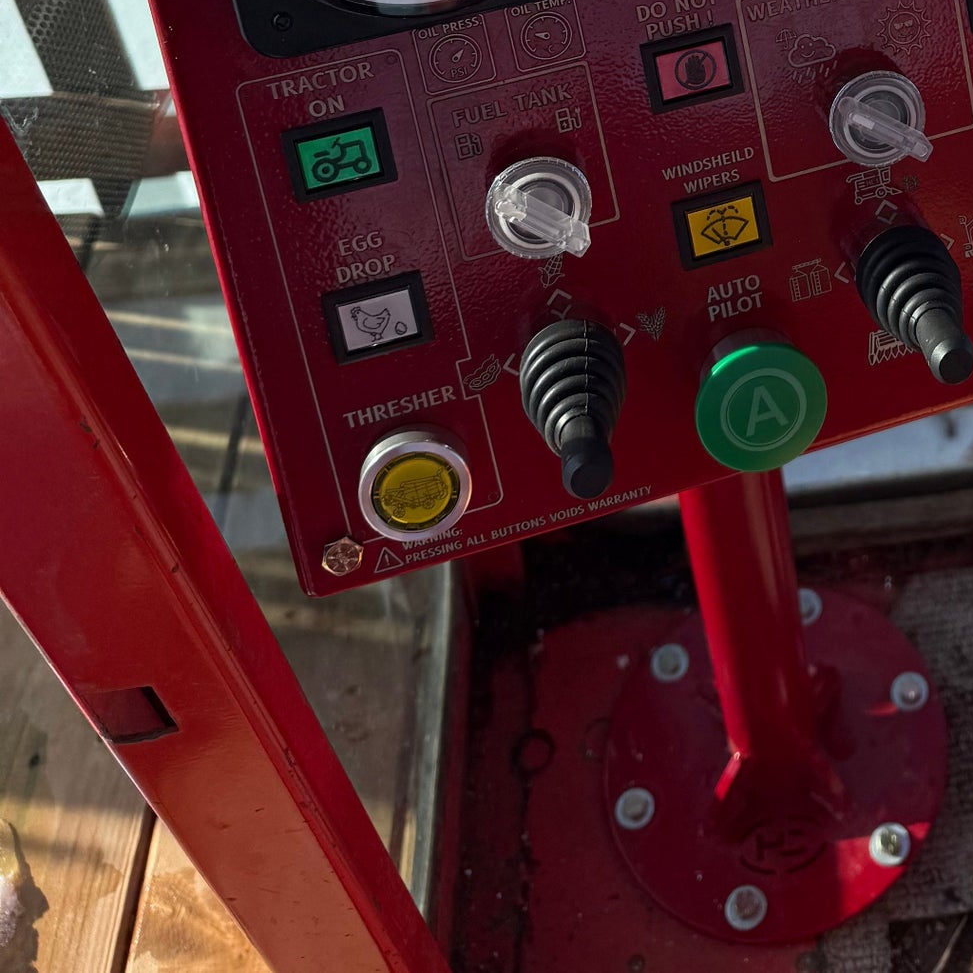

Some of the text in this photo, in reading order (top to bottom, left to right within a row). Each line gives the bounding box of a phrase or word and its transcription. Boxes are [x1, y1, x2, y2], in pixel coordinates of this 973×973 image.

[511, 5, 531, 17] OIL
[635, 2, 667, 24] DO
[418, 16, 483, 40] OIL PRESS.
[266, 61, 374, 100] TRACTOR
[451, 67, 468, 78] PSI
[309, 95, 345, 118] ON
[451, 82, 574, 128] FUEL TANK
[662, 147, 755, 180] WINDSHEILD
[684, 168, 740, 194] WIPERS
[338, 231, 383, 257] EGG
[336, 254, 396, 284] DROP
[707, 274, 760, 303] AUTO
[708, 291, 763, 322] PILOT
[343, 385, 456, 428] THRESHER
[745, 385, 786, 436] A
[405, 485, 651, 564] PRESSING ALL BUTTONS VOIDS WARRANTY
